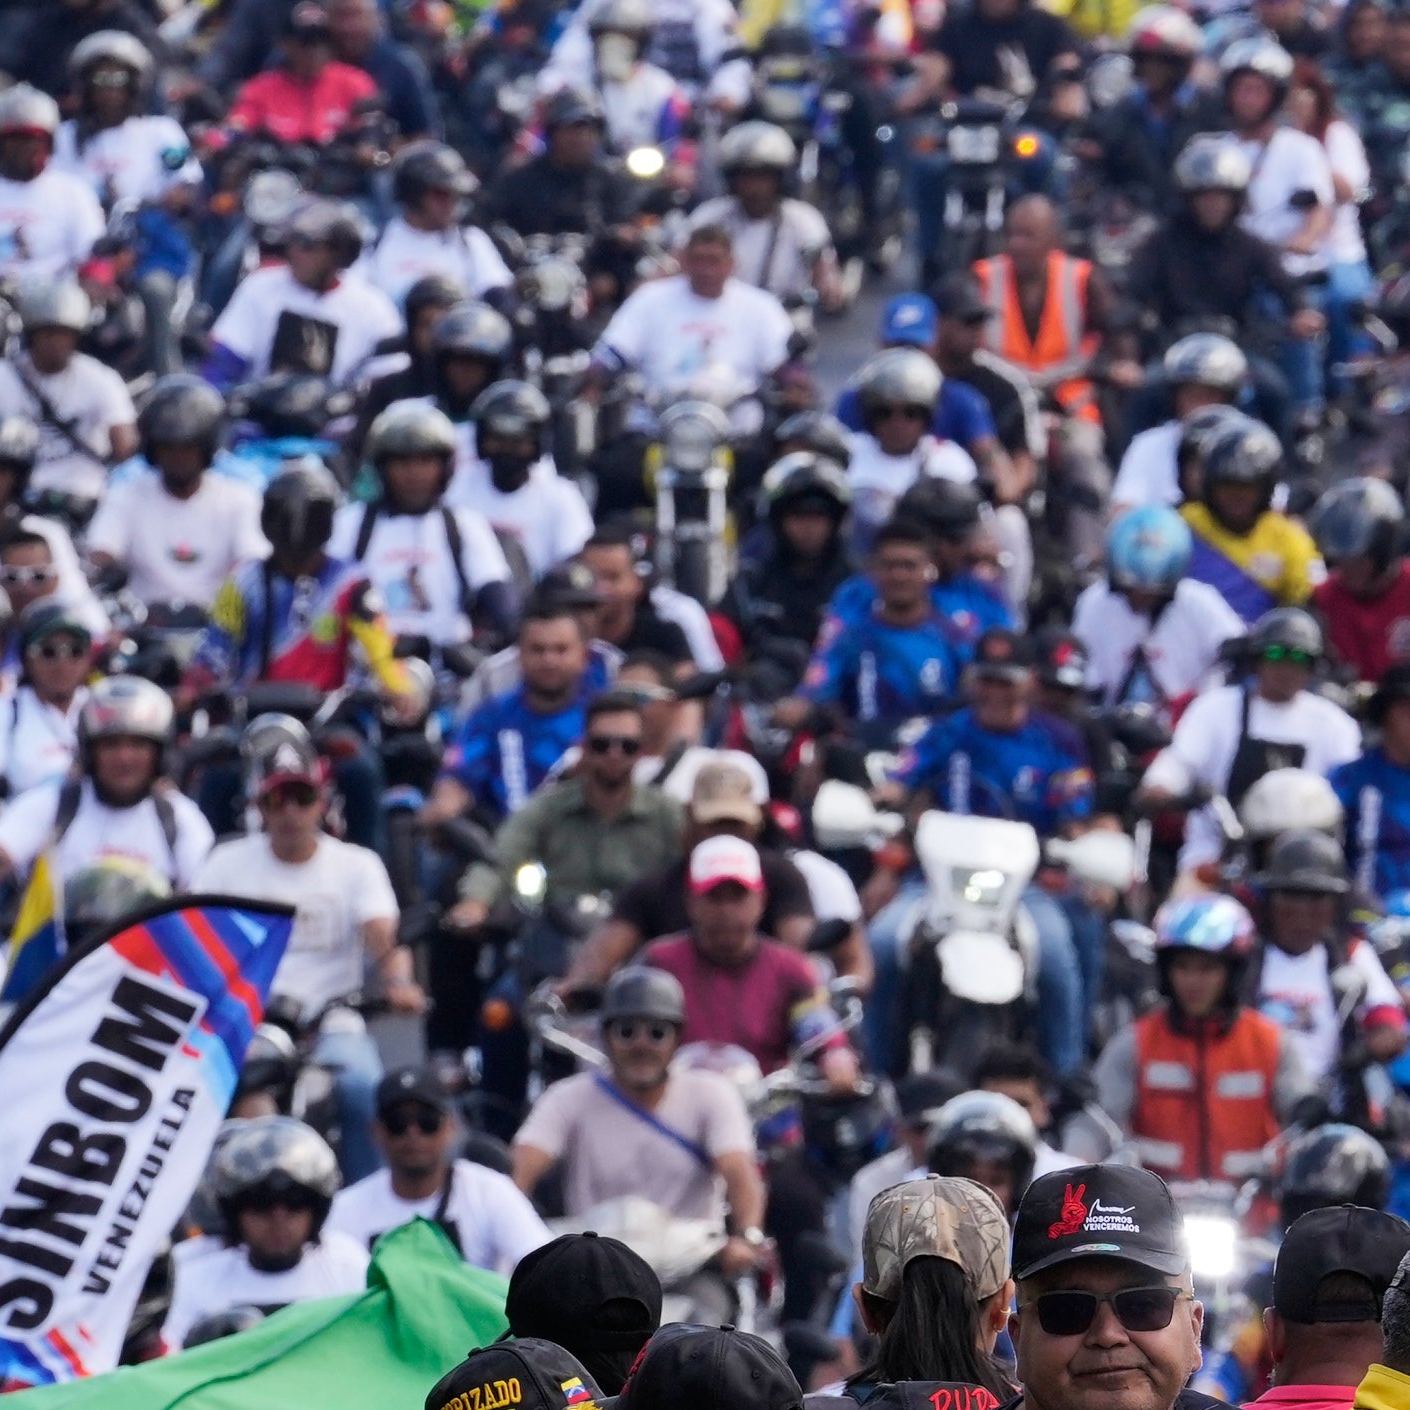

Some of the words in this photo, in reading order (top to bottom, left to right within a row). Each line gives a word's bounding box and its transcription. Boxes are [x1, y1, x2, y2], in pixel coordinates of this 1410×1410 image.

[81, 1088, 196, 1295] VENEZUELA
[1085, 1216, 1132, 1224] NOSOTROS
[1083, 1223, 1140, 1233] VENCEREMOS
